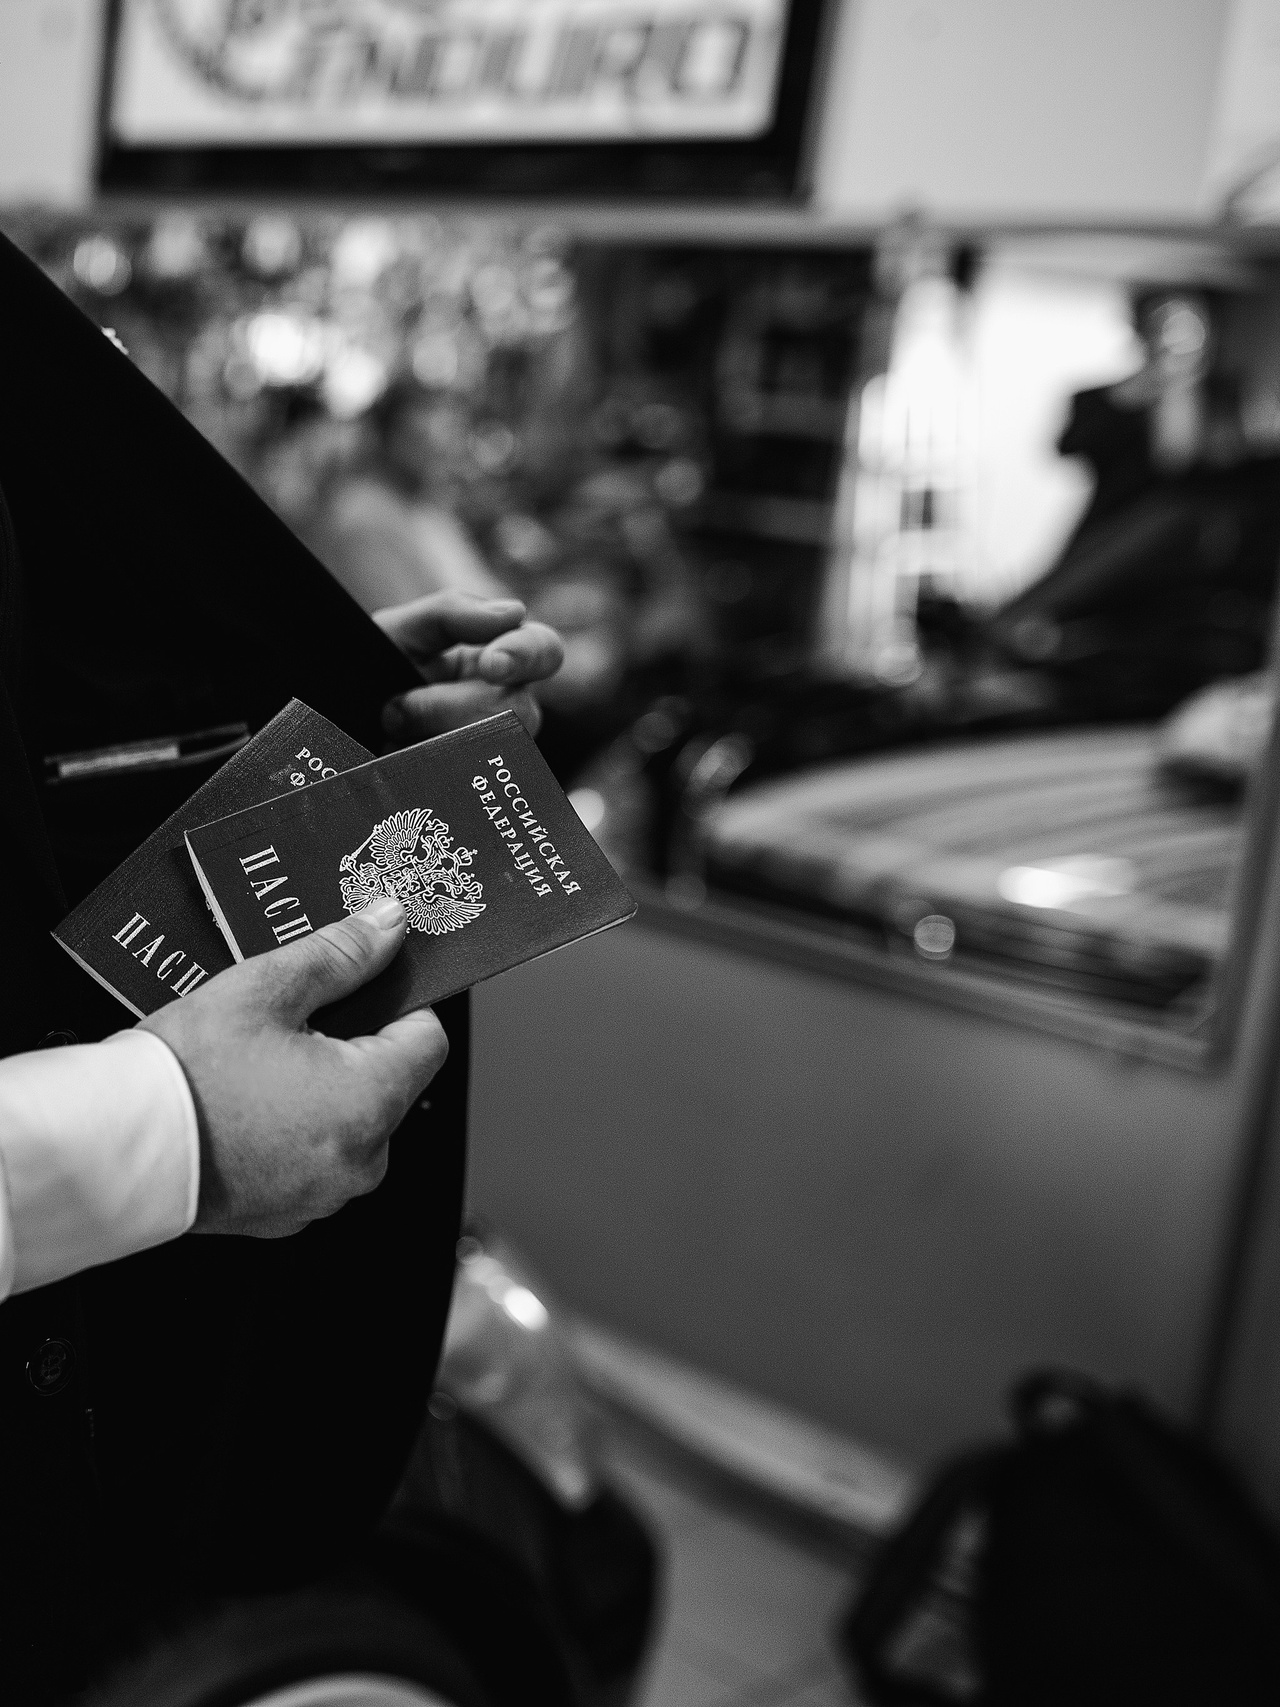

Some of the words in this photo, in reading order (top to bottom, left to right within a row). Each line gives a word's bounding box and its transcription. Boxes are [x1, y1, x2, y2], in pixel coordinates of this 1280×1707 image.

[471, 775, 553, 897] ФЕДЕРАЦИЯ
[487, 755, 582, 896] РОССИЙСКАЯ
[239, 845, 314, 944] ПАСП
[111, 912, 209, 998] ПАСП
